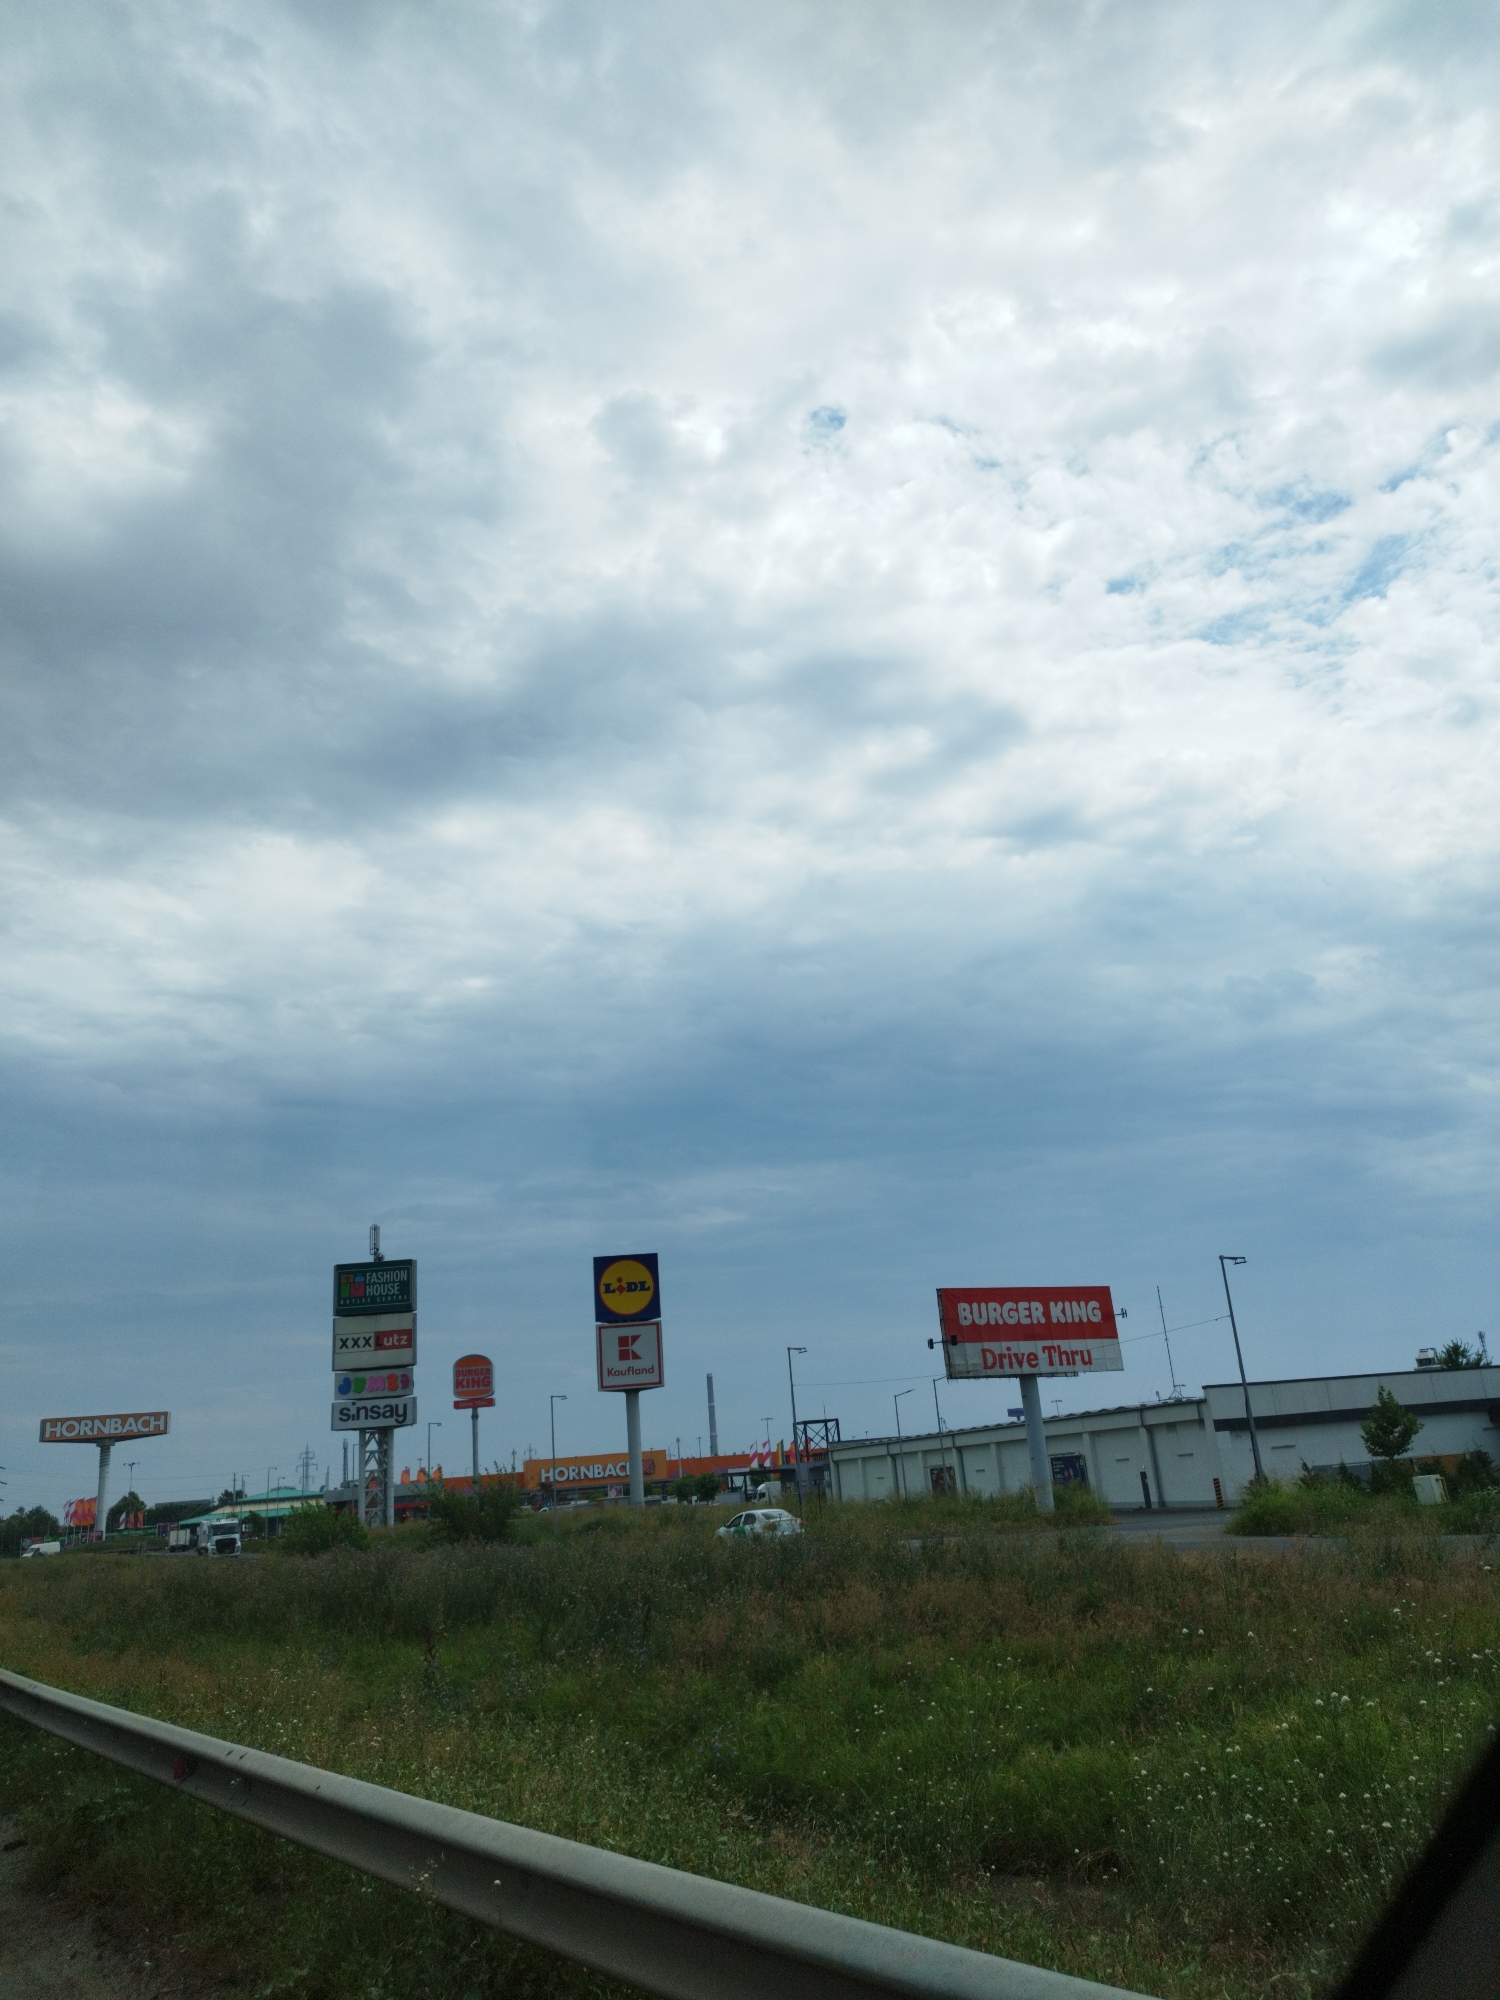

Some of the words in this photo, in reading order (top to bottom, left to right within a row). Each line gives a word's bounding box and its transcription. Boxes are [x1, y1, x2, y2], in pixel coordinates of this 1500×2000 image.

[366, 1269, 408, 1284] FASHION
[366, 1282, 400, 1296] HOUSE
[957, 1301, 1046, 1326] BURGER
[1049, 1300, 1102, 1323] KING
[981, 1346, 1039, 1370] Drive
[1042, 1345, 1093, 1367] Thru
[455, 1368, 491, 1377] BURGER
[607, 1365, 655, 1378] Kaufland
[338, 1373, 410, 1395] JUMBO
[455, 1375, 491, 1389] KING
[338, 1402, 408, 1424] sinsay
[45, 1415, 165, 1439] HORNBACH
